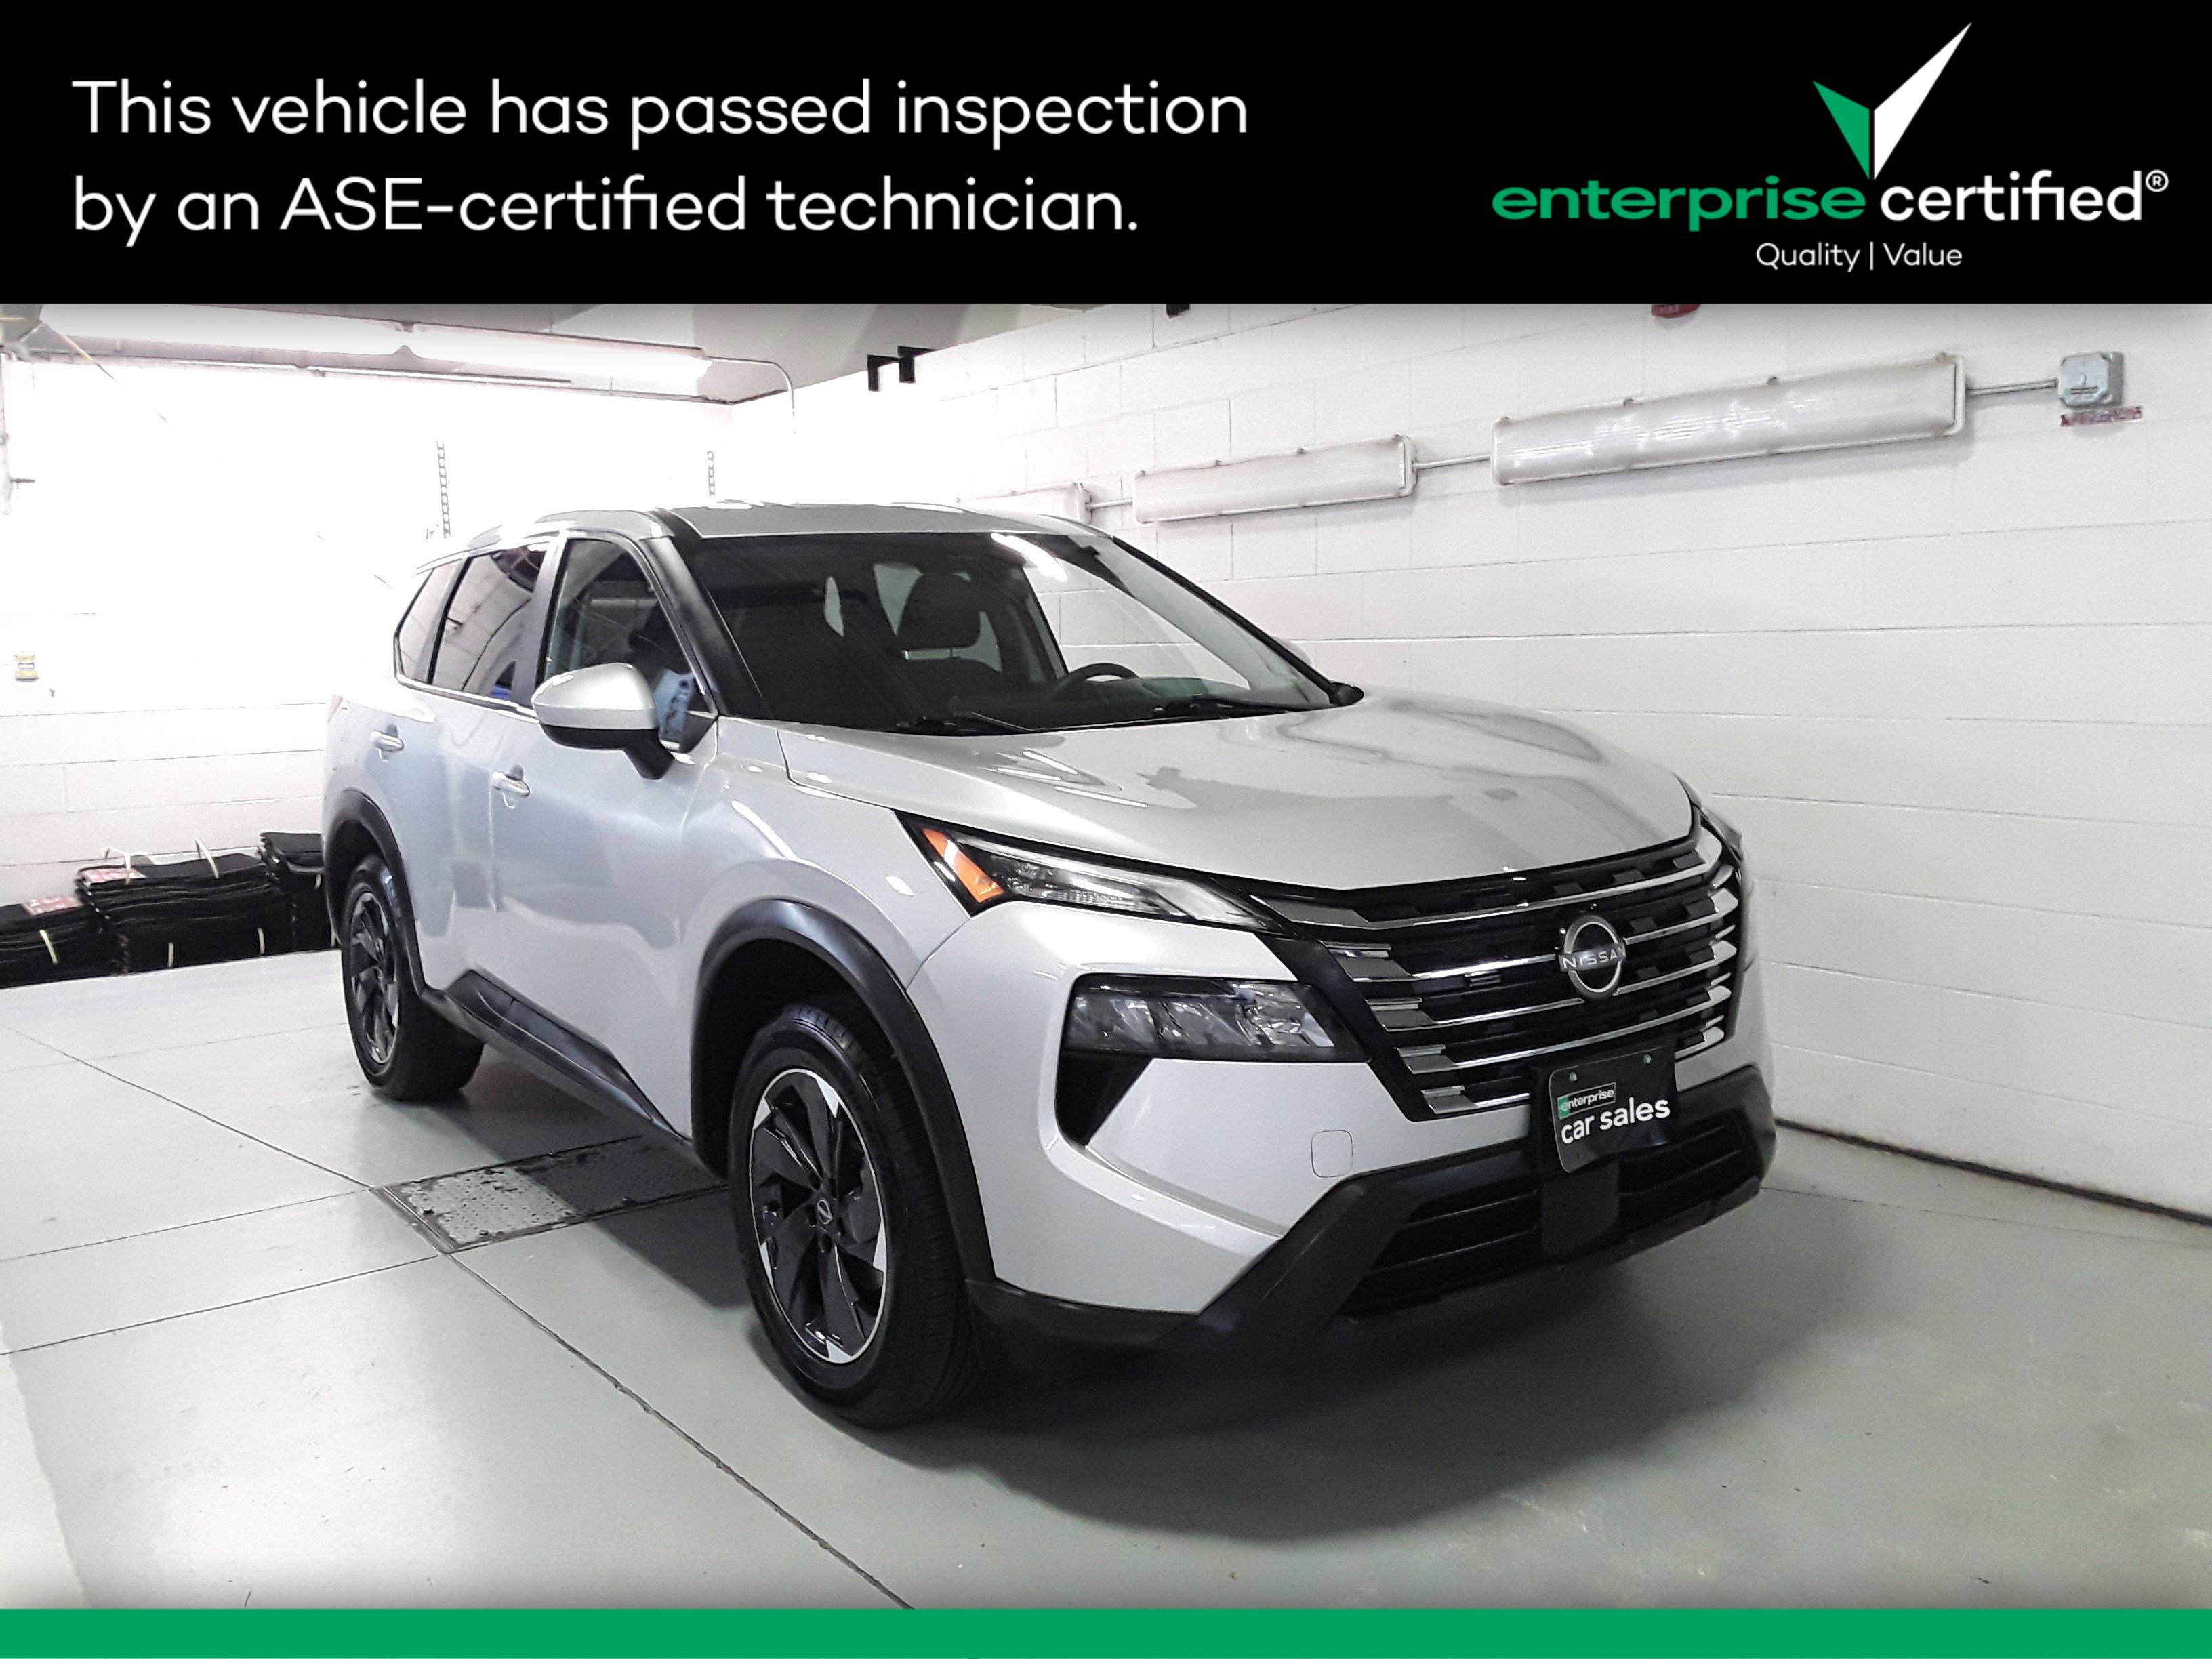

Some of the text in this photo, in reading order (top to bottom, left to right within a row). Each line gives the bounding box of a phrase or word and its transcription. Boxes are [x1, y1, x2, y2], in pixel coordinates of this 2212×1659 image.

[1563, 945, 1625, 969] NISSAN
[1559, 1089, 1614, 1112] enterprise
[1561, 1097, 1671, 1144] car sales
